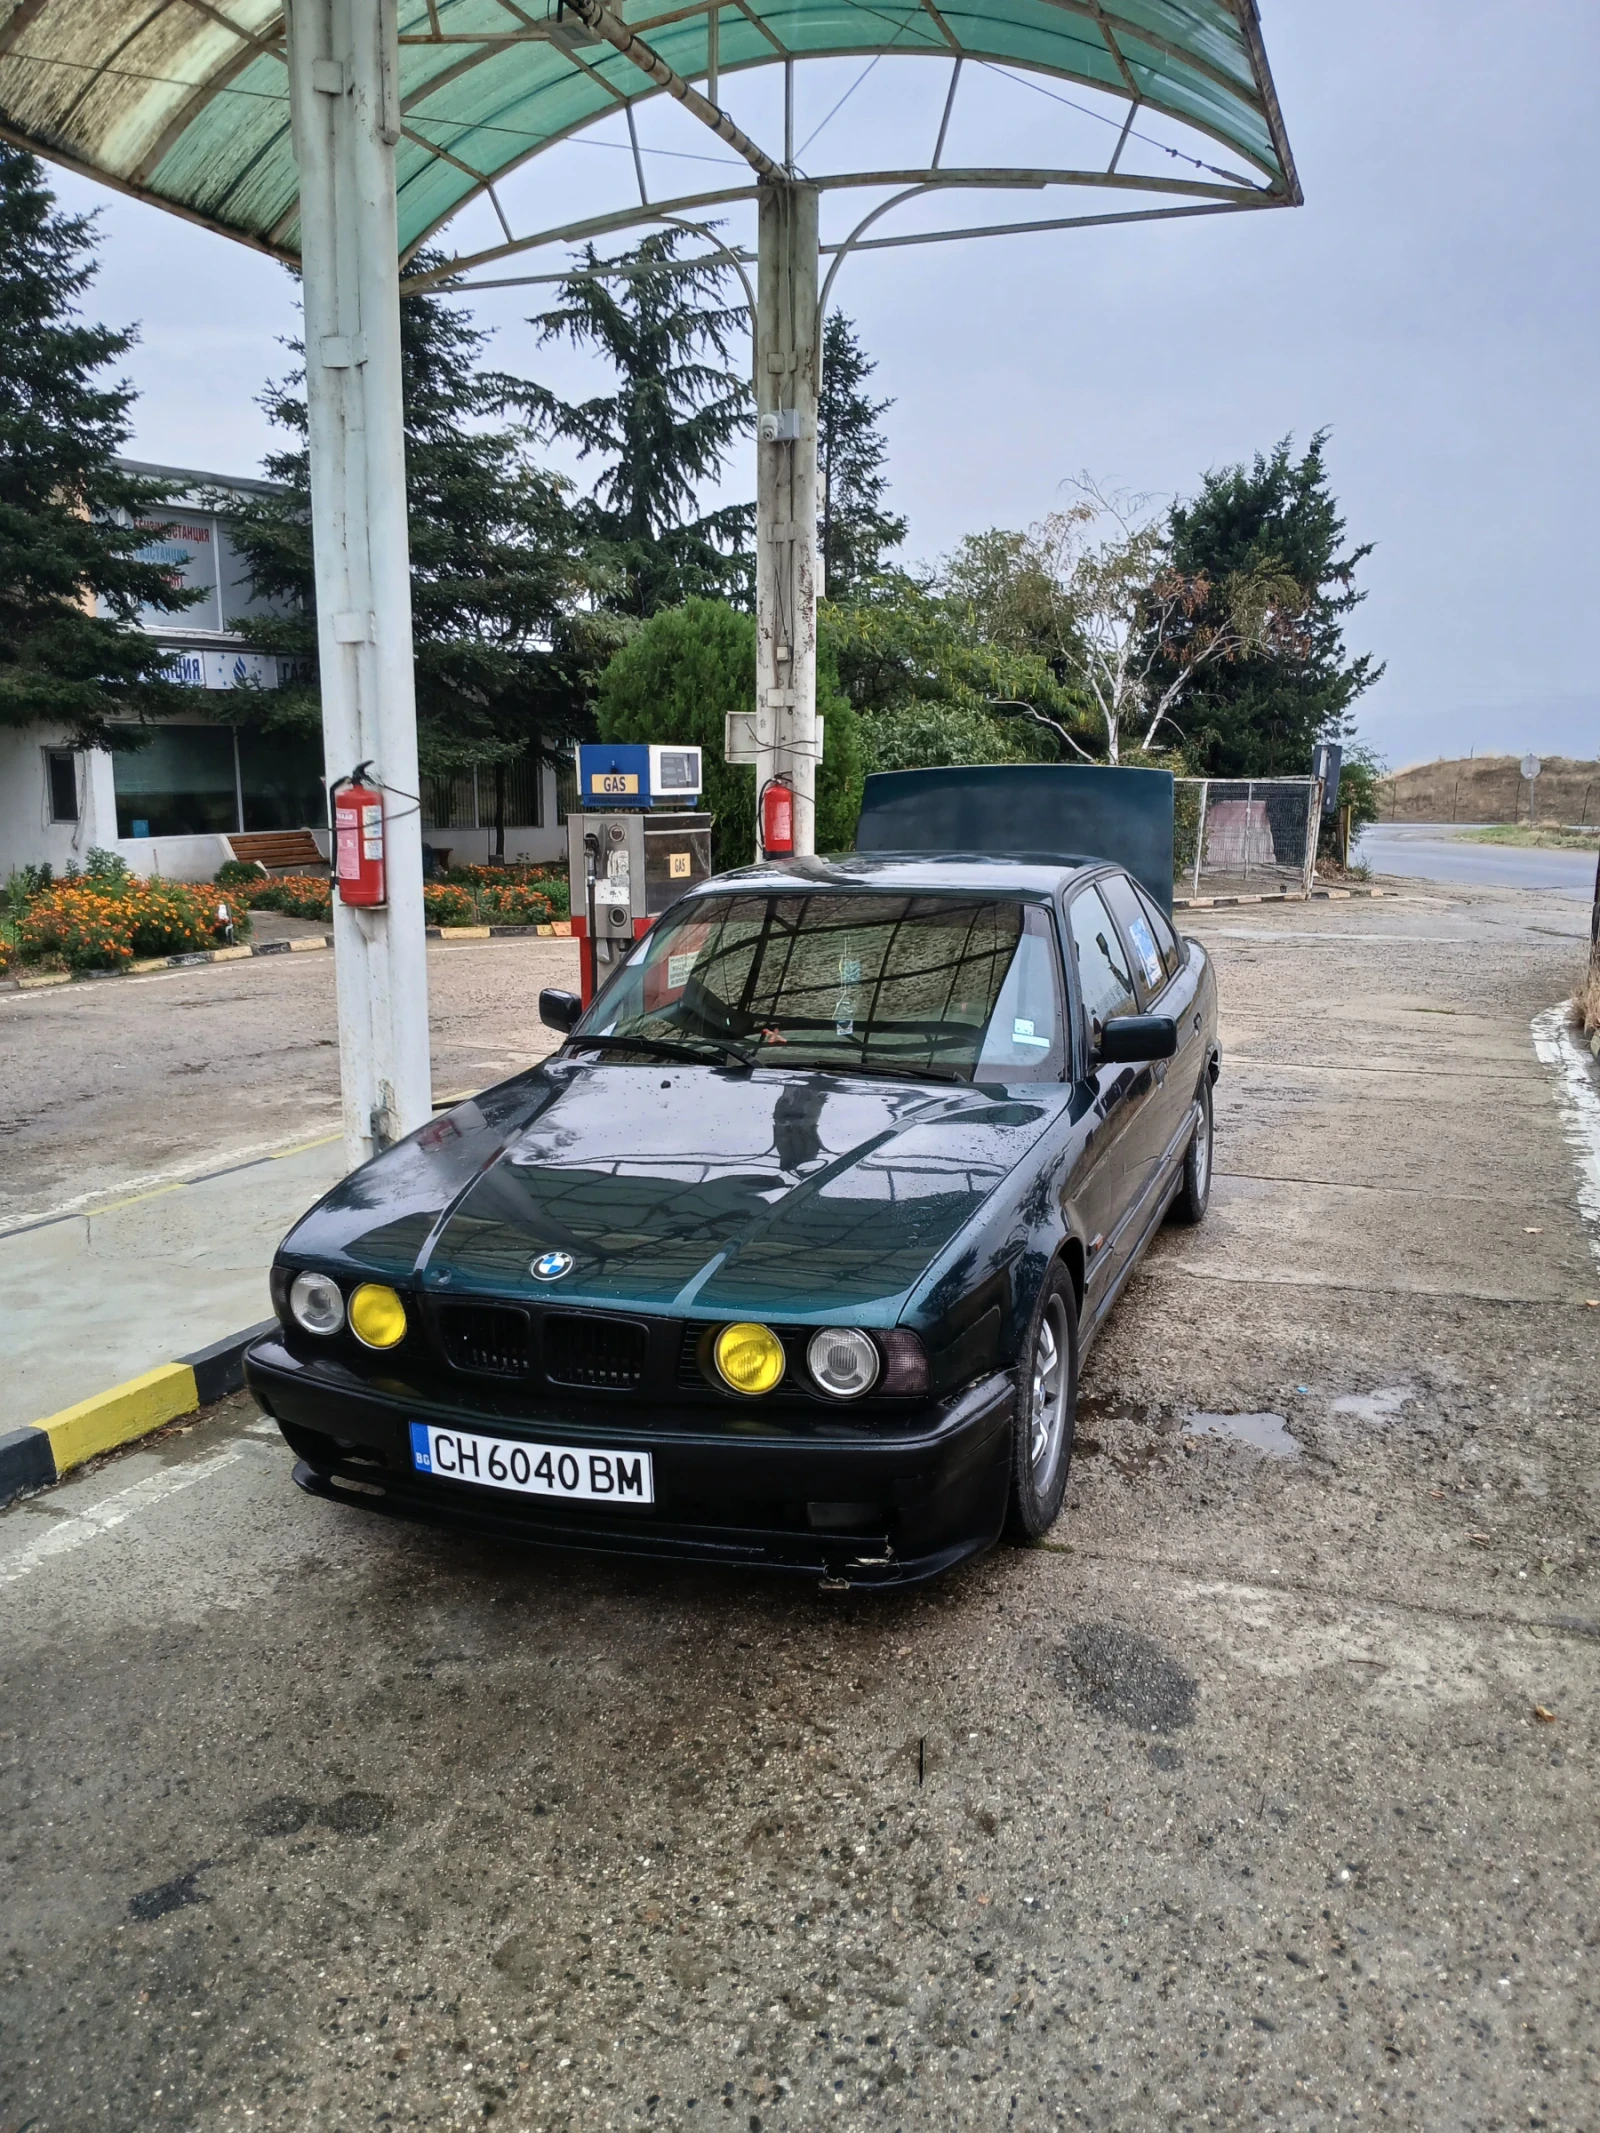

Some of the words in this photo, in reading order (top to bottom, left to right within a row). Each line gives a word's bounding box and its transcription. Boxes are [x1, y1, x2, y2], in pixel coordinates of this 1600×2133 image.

[603, 776, 626, 792] GAS
[674, 858, 686, 873] GAS
[415, 1452, 431, 1466] BG
[588, 1455, 644, 1496] BM
